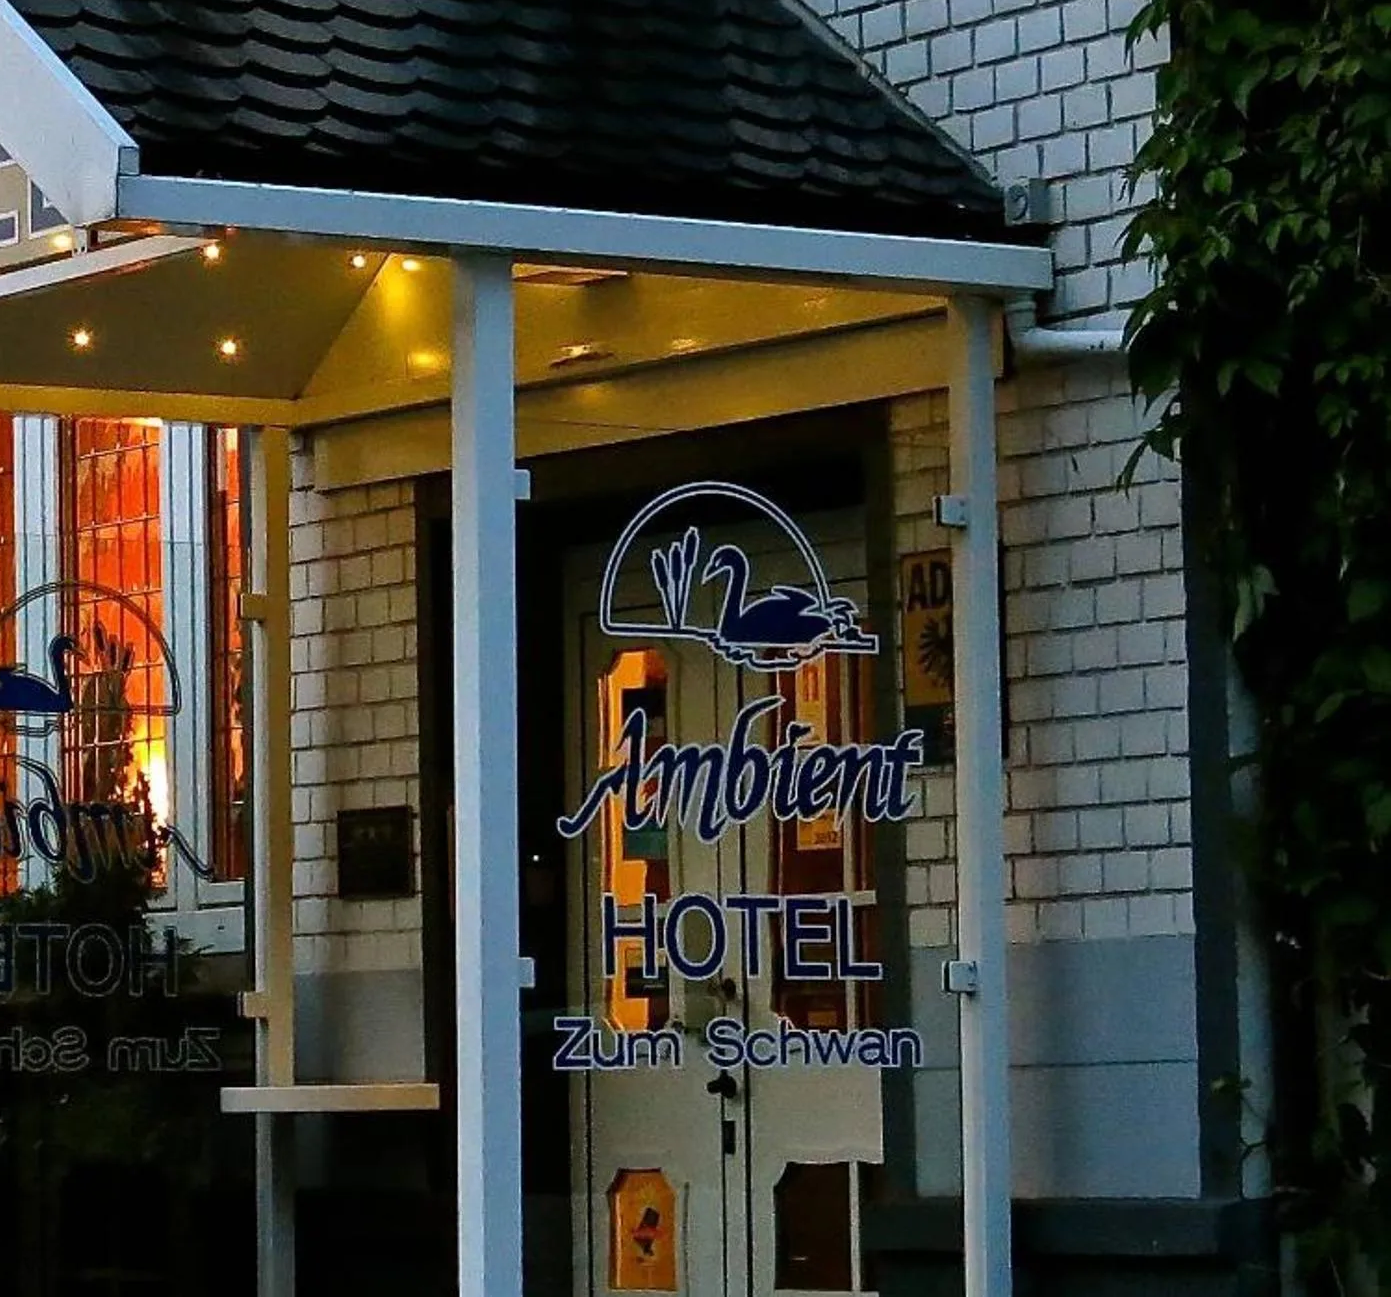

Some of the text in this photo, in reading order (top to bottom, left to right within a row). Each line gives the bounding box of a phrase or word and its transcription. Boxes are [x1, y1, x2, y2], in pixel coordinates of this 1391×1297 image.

[557, 697, 924, 843] Ambient
[601, 893, 883, 980] HOTEL
[553, 1016, 923, 1070] Zum Schwan
